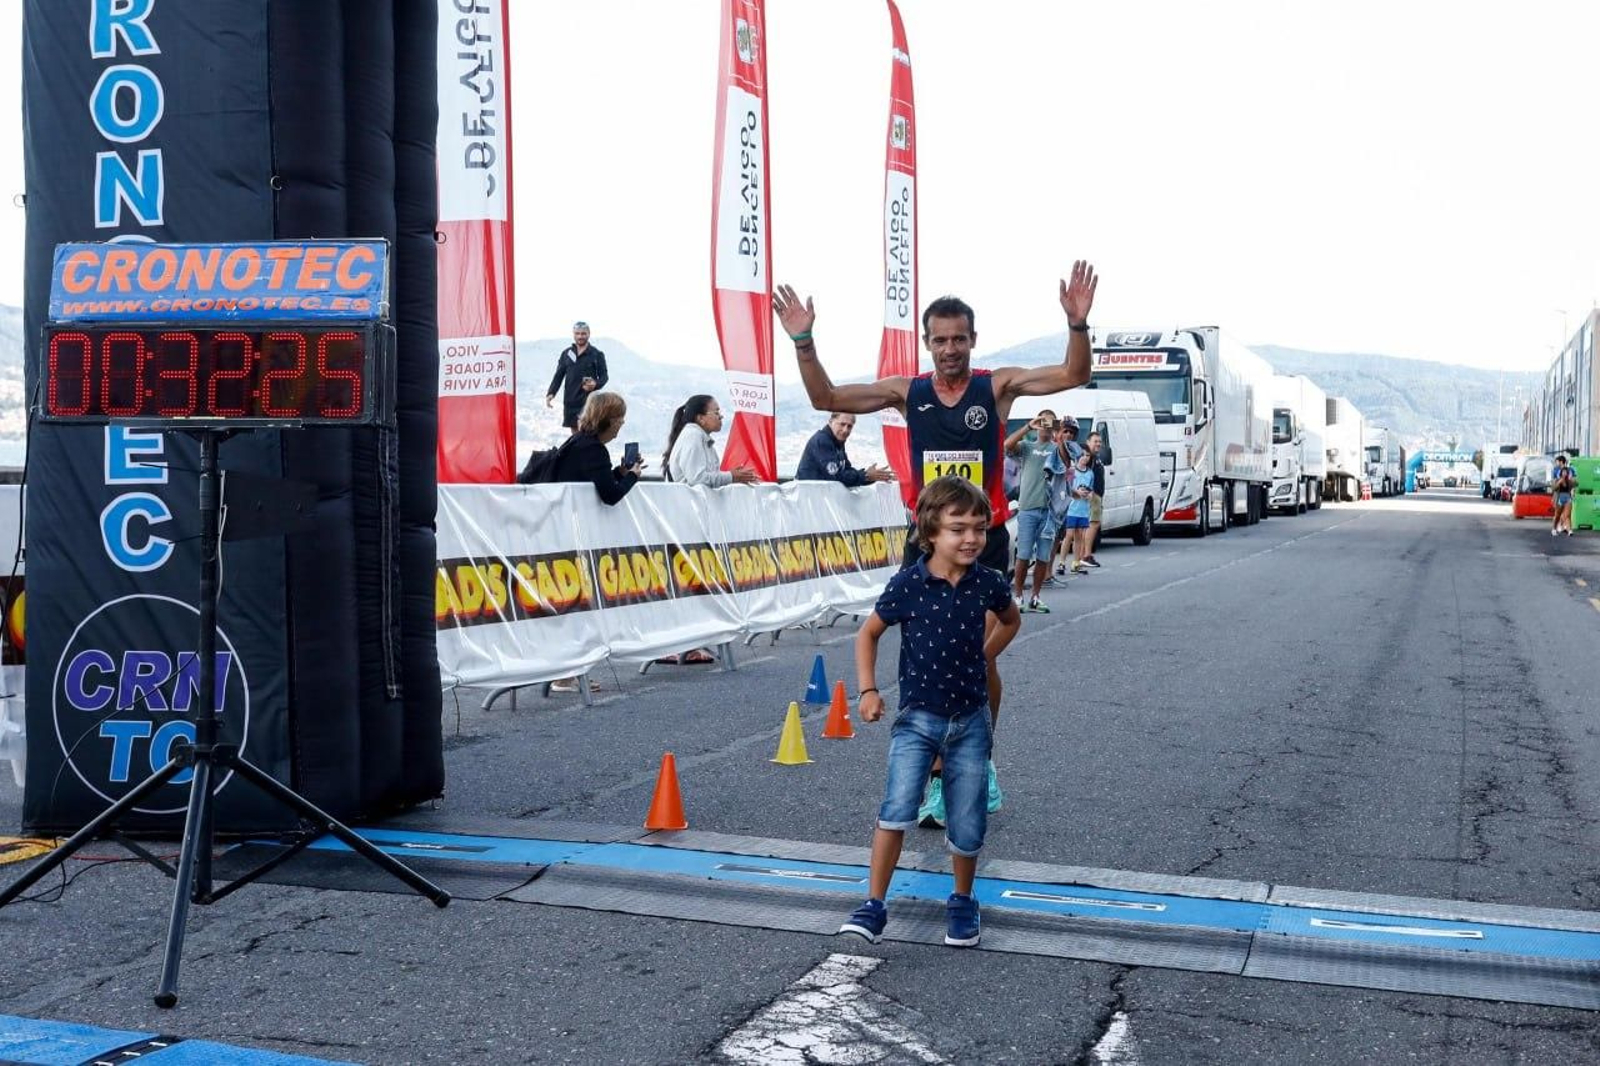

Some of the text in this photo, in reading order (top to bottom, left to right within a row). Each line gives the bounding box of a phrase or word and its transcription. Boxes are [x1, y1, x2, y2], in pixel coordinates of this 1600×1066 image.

[61, 247, 376, 294] CRONOTEC
[48, 332, 361, 416] 00:32:25
[935, 463, 971, 480] 140
[436, 564, 508, 619] ADIS
